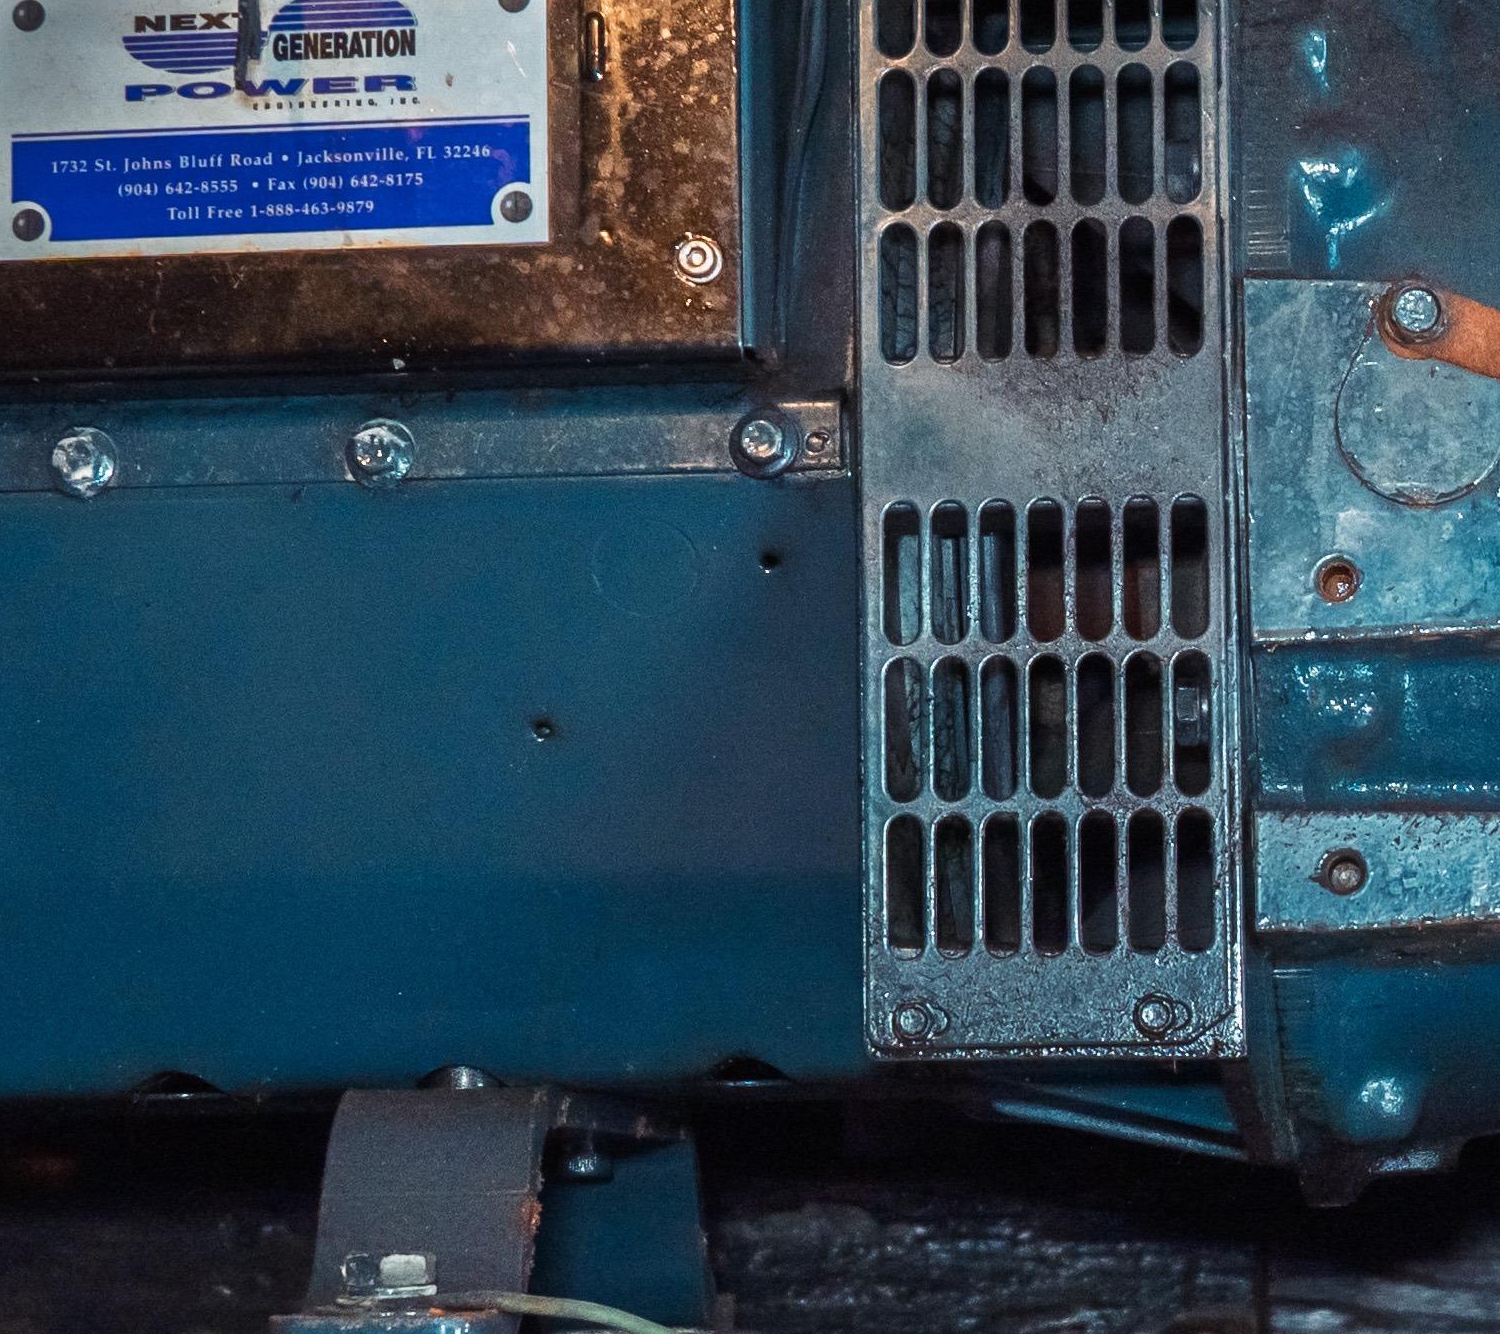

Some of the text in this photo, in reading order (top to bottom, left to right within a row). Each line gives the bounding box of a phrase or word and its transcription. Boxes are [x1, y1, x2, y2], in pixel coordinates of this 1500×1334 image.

[134, 12, 242, 33] NEX
[272, 29, 416, 62] GENERATION
[125, 74, 417, 102] POWER
[390, 97, 421, 107] INC.
[51, 144, 491, 173] 1732 St. Johns Bluff Road Jacksonville, FL 32246
[117, 172, 424, 197] (904) 642-8555 Fax (904) 642-8175
[167, 200, 374, 220] Toll Free 1-888-463-9879
